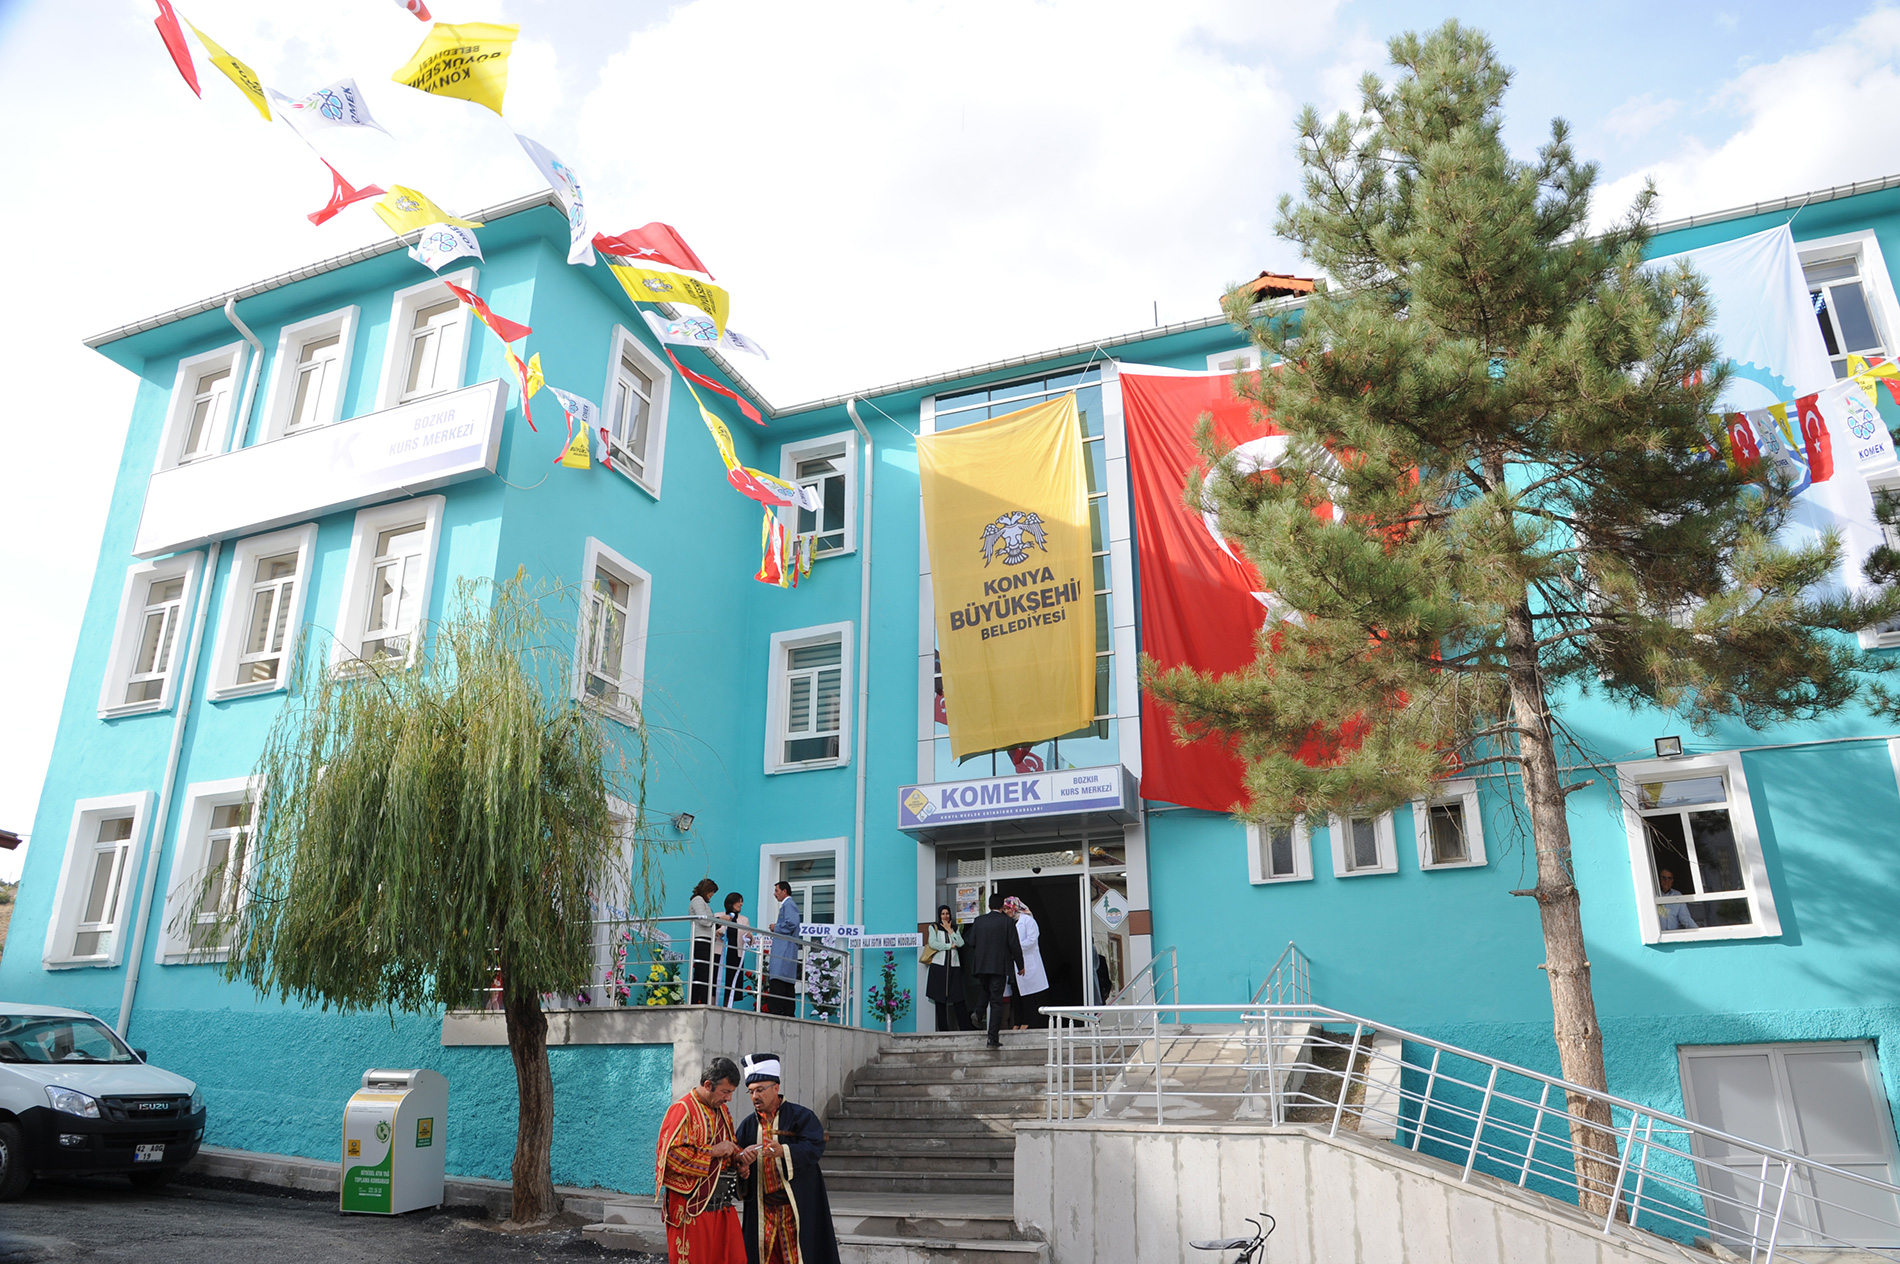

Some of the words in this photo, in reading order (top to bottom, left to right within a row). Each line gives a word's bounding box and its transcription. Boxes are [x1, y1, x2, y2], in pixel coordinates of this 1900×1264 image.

[340, 86, 361, 124] OMEK
[414, 408, 456, 431] BOZKIR
[389, 437, 419, 456] KURS
[422, 419, 475, 447] MERKEZİ
[1858, 443, 1885, 459] KOMEK
[984, 566, 1055, 597] KONYA
[981, 606, 1066, 641] BELEDİYESİ
[1060, 786, 1080, 797] KURS
[1081, 782, 1113, 795] MERKEZİ
[1072, 775, 1099, 785] BOZKIR
[941, 779, 1041, 810] KOMEK
[801, 924, 831, 935] ZGÜR
[837, 925, 859, 936] ÖRS
